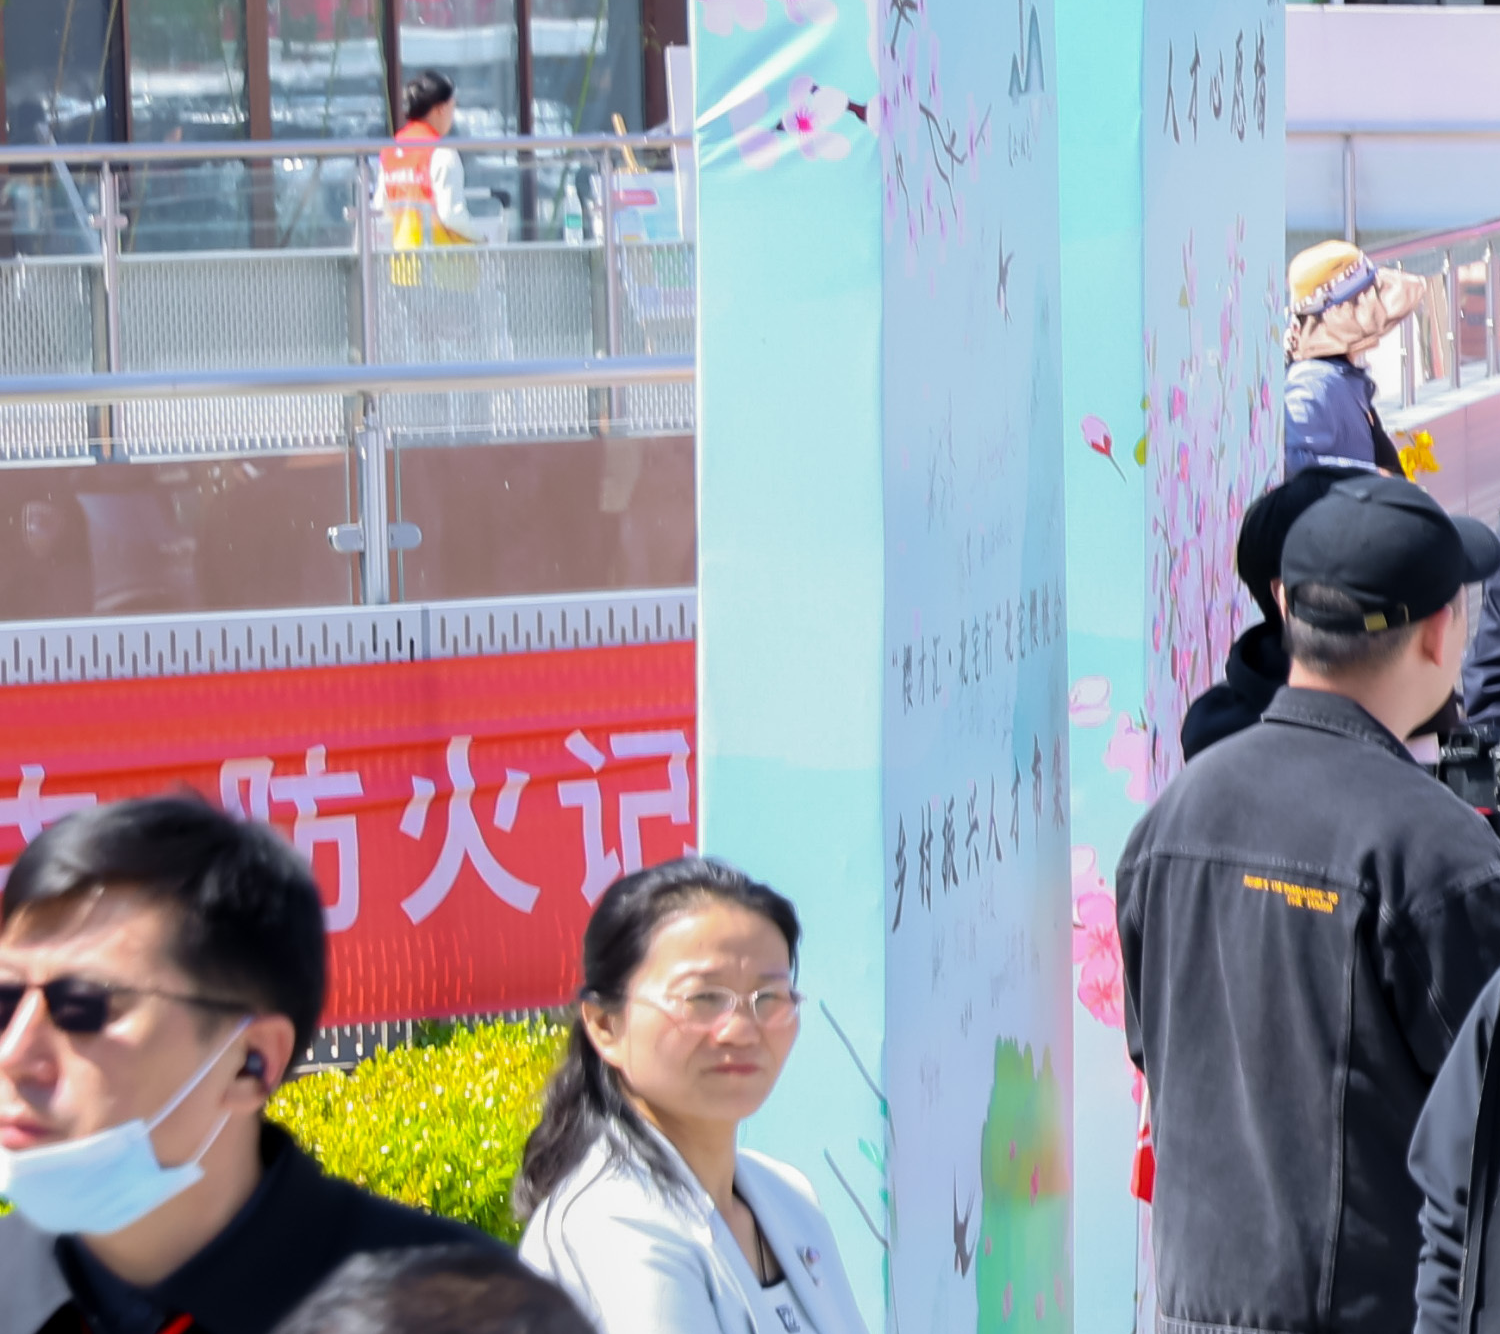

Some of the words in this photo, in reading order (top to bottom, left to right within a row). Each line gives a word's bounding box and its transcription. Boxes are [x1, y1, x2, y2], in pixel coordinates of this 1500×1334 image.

[1163, 22, 1268, 146] 人才心愿墙
[892, 733, 1066, 934] 乡村振兴人才市集
